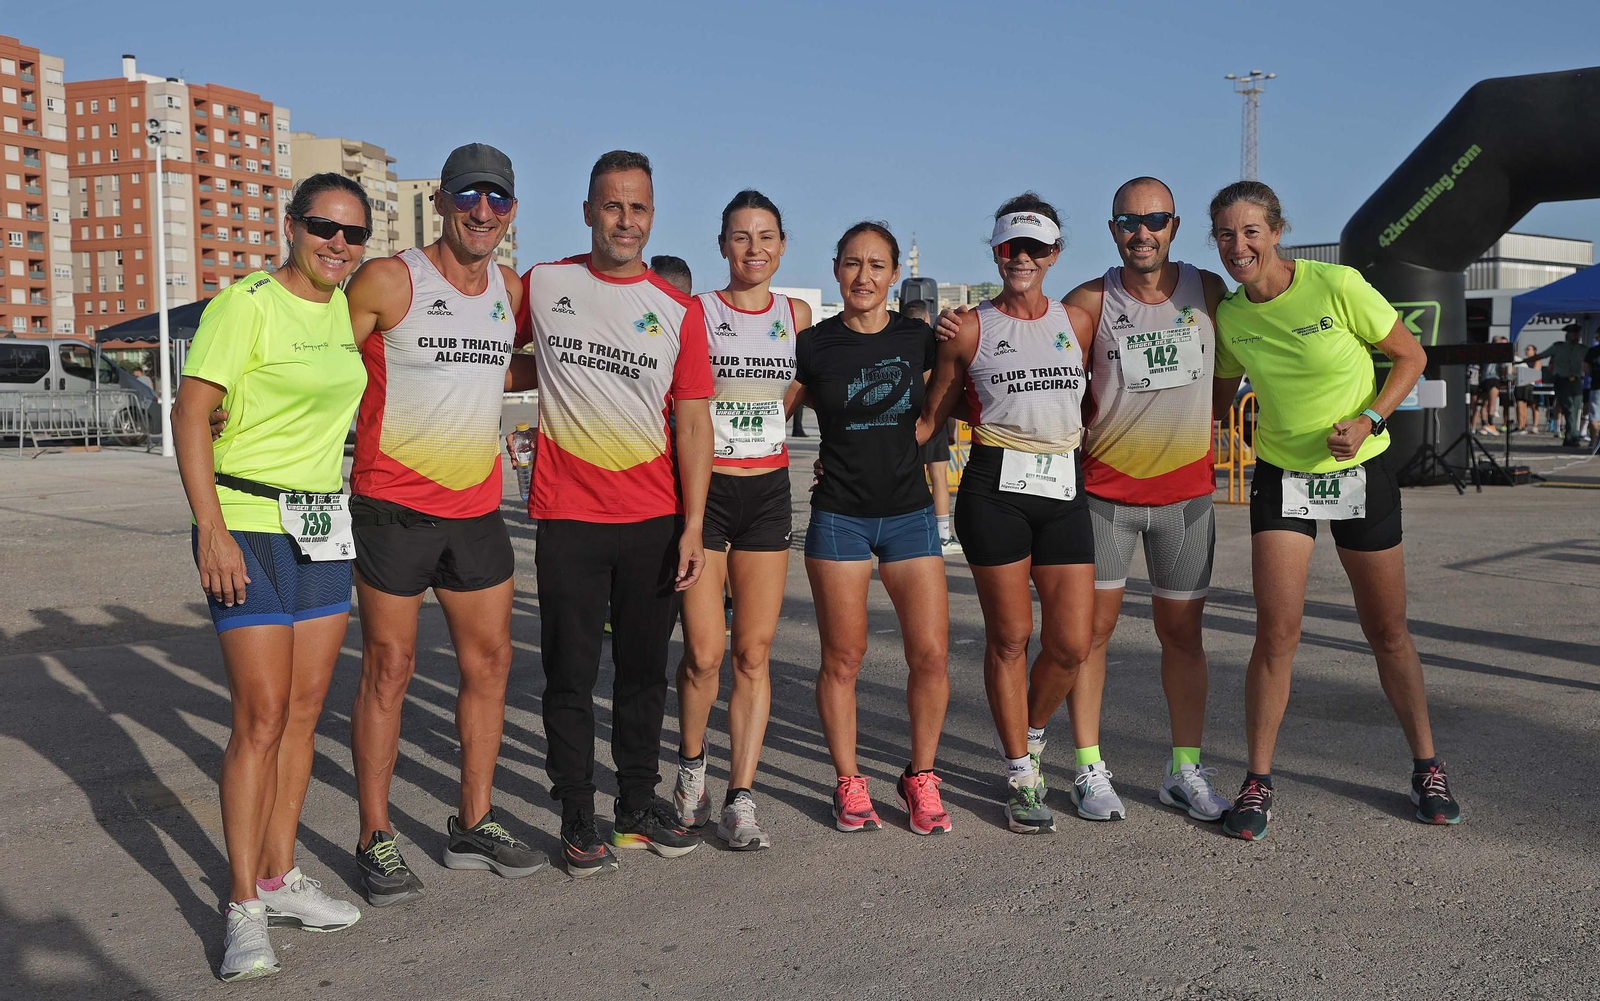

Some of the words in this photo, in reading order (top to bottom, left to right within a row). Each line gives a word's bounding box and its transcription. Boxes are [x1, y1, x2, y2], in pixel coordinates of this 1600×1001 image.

[1379, 144, 1482, 247] 42krunning.com
[418, 337, 457, 348] CLUB
[461, 339, 512, 354] TRIATLÓN
[1127, 332, 1162, 344] XXVI
[1128, 342, 1152, 350] VIRGEN
[435, 352, 505, 366] ALGECIRAS
[548, 335, 582, 350] CLUB
[588, 342, 657, 370] TRIATLÓN
[1143, 345, 1178, 368] 142
[560, 352, 640, 380] ALGECIRAS
[717, 369, 791, 380] ALGECIRAS
[991, 370, 1026, 384] CLUB
[1007, 380, 1078, 394] ALGECIRAS
[730, 416, 763, 436] 148
[1305, 480, 1341, 499] 144
[301, 512, 332, 536] 138
